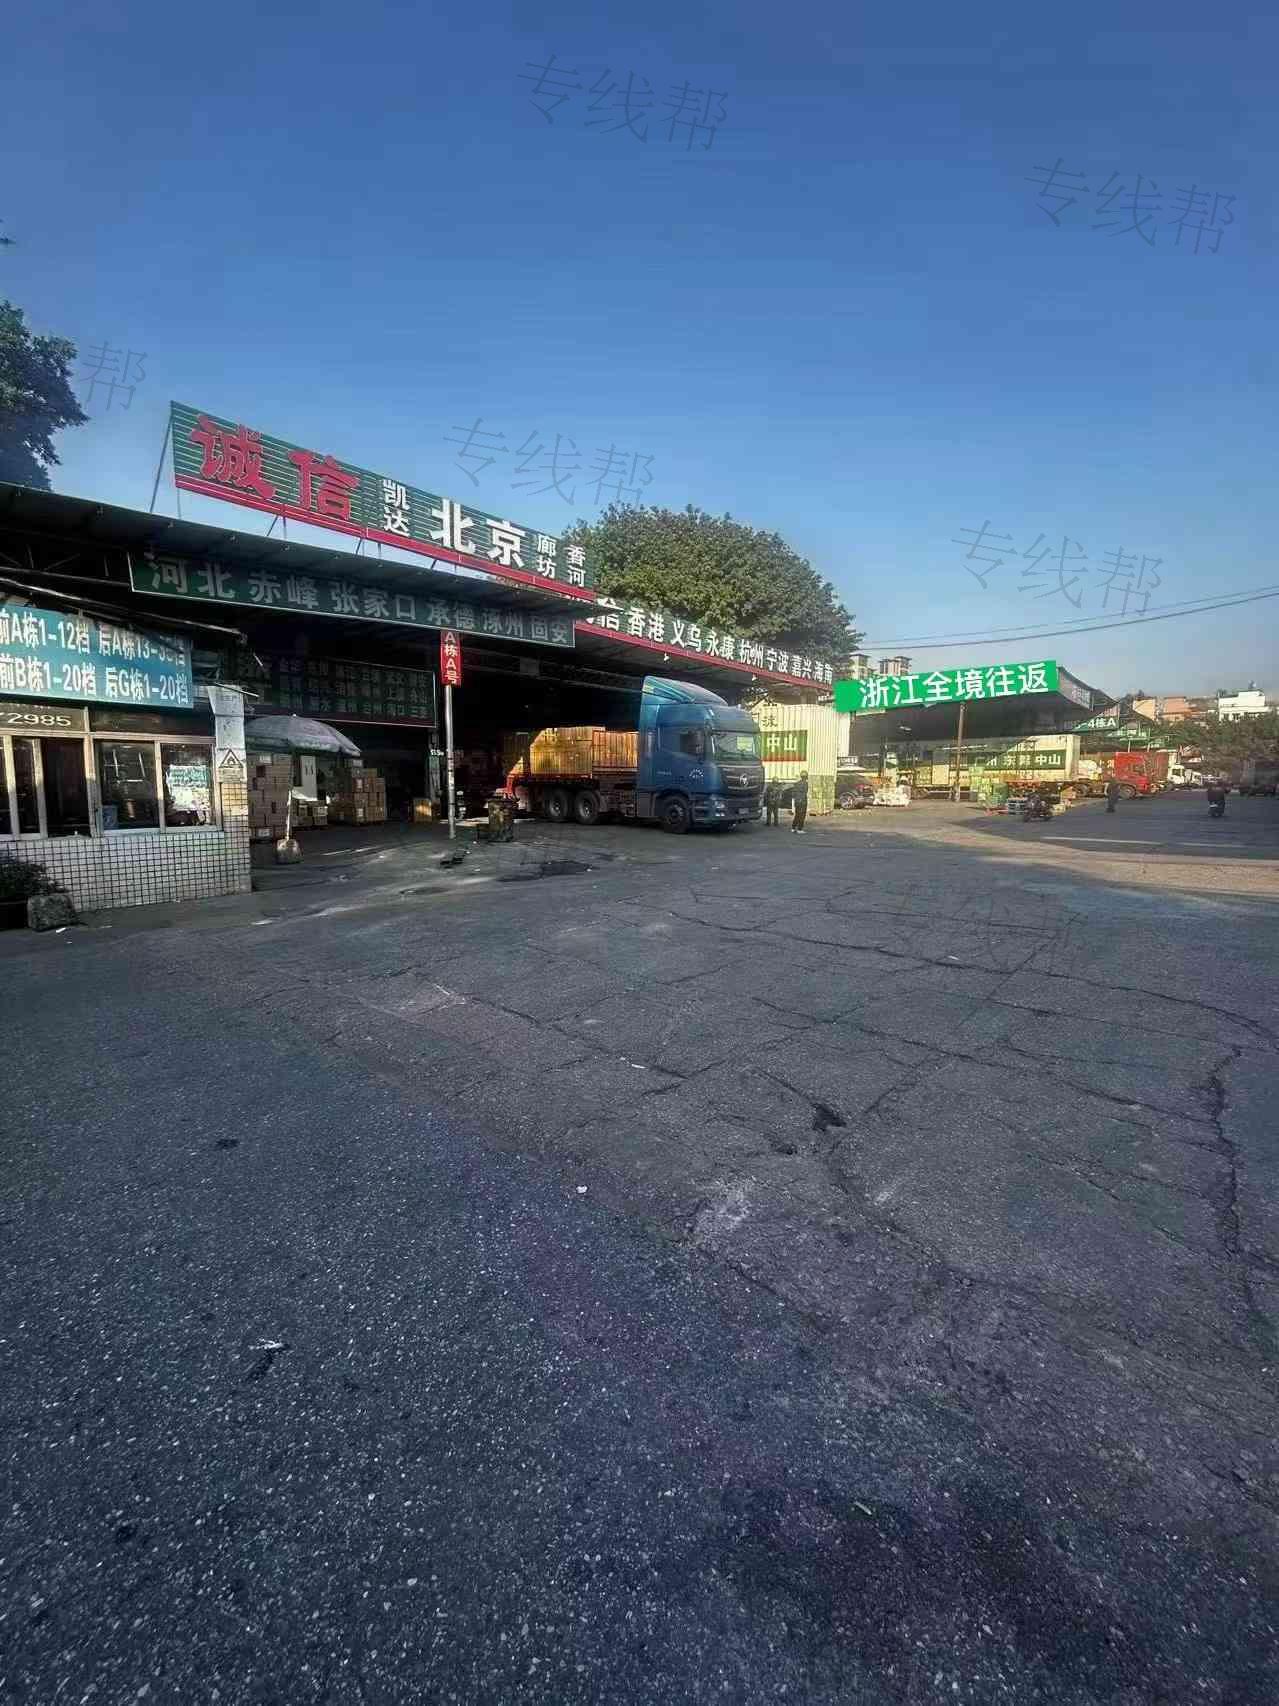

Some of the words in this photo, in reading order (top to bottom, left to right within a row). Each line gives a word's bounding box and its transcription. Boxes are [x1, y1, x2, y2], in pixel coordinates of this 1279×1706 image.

[190, 413, 361, 521] 诚信
[382, 478, 411, 538] 凯达
[430, 498, 526, 569] 北京
[537, 533, 557, 580] 廊坊
[567, 544, 587, 588] 香河
[147, 556, 235, 599] 河北
[248, 570, 319, 610] 赤峰
[327, 580, 416, 620] 张家口
[531, 615, 568, 643] 固安
[627, 607, 664, 643] 香港
[671, 619, 701, 653] 义乌
[706, 626, 735, 660] 永康
[739, 638, 764, 668] 杭州
[767, 649, 789, 674] 宁波
[791, 654, 813, 679] 嘉兴
[860, 662, 1049, 708] 浙江全境往返
[0, 712, 72, 727] 2985
[767, 734, 797, 752] 中山
